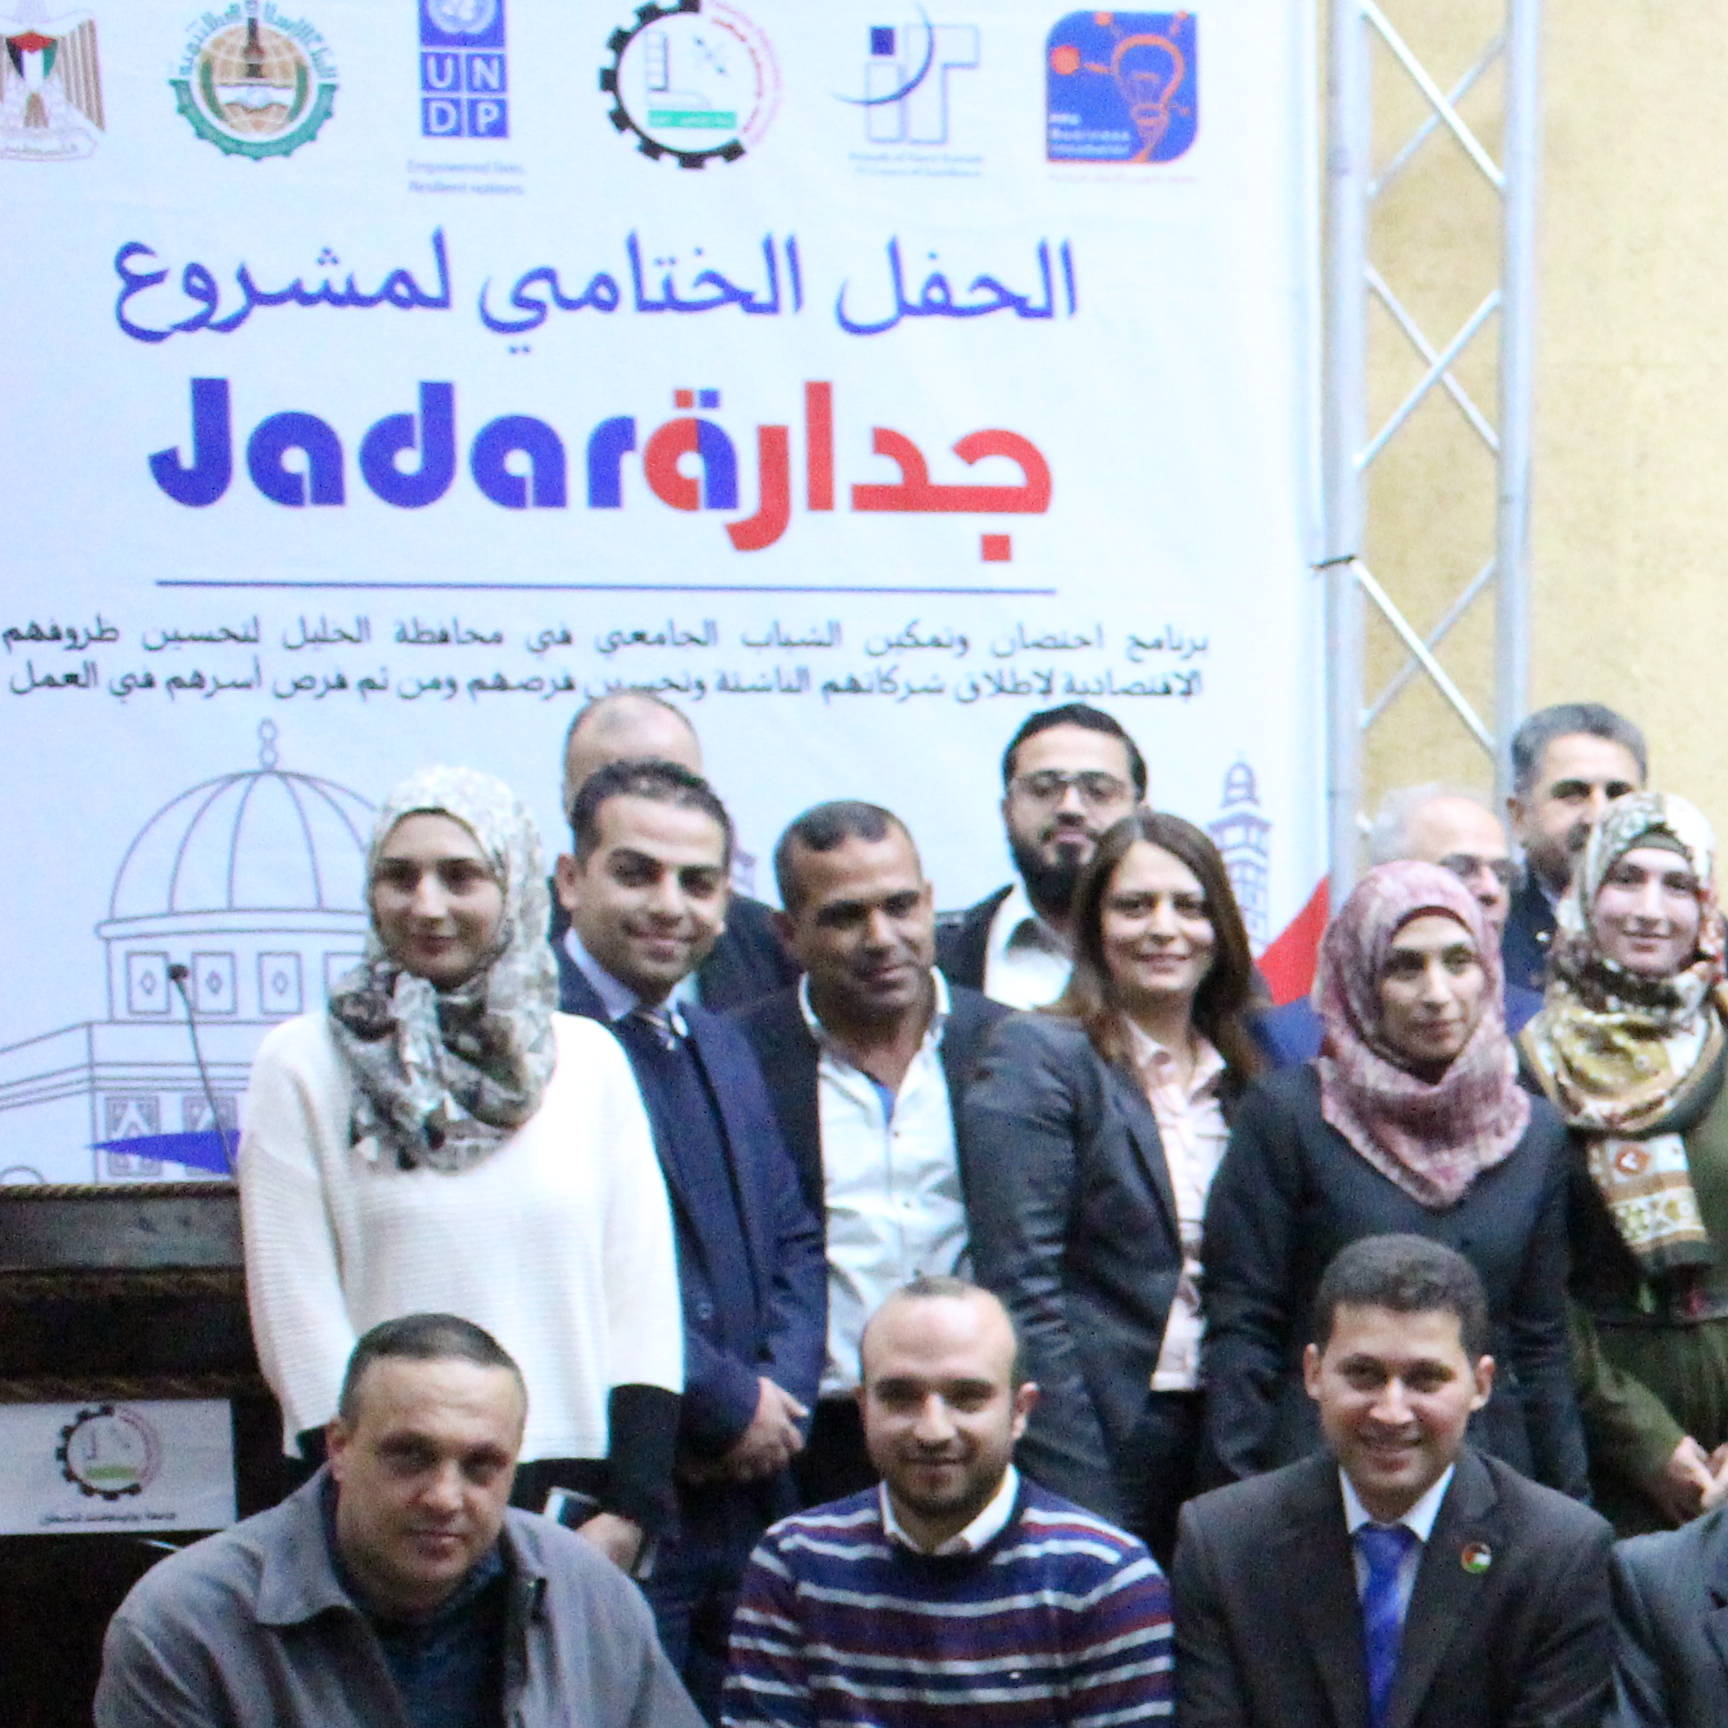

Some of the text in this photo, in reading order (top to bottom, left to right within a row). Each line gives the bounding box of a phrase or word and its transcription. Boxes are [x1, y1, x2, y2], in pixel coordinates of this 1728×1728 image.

[114, 228, 1075, 353] الحفل الختامي لمشروع
[644, 381, 1050, 560] جدارة
